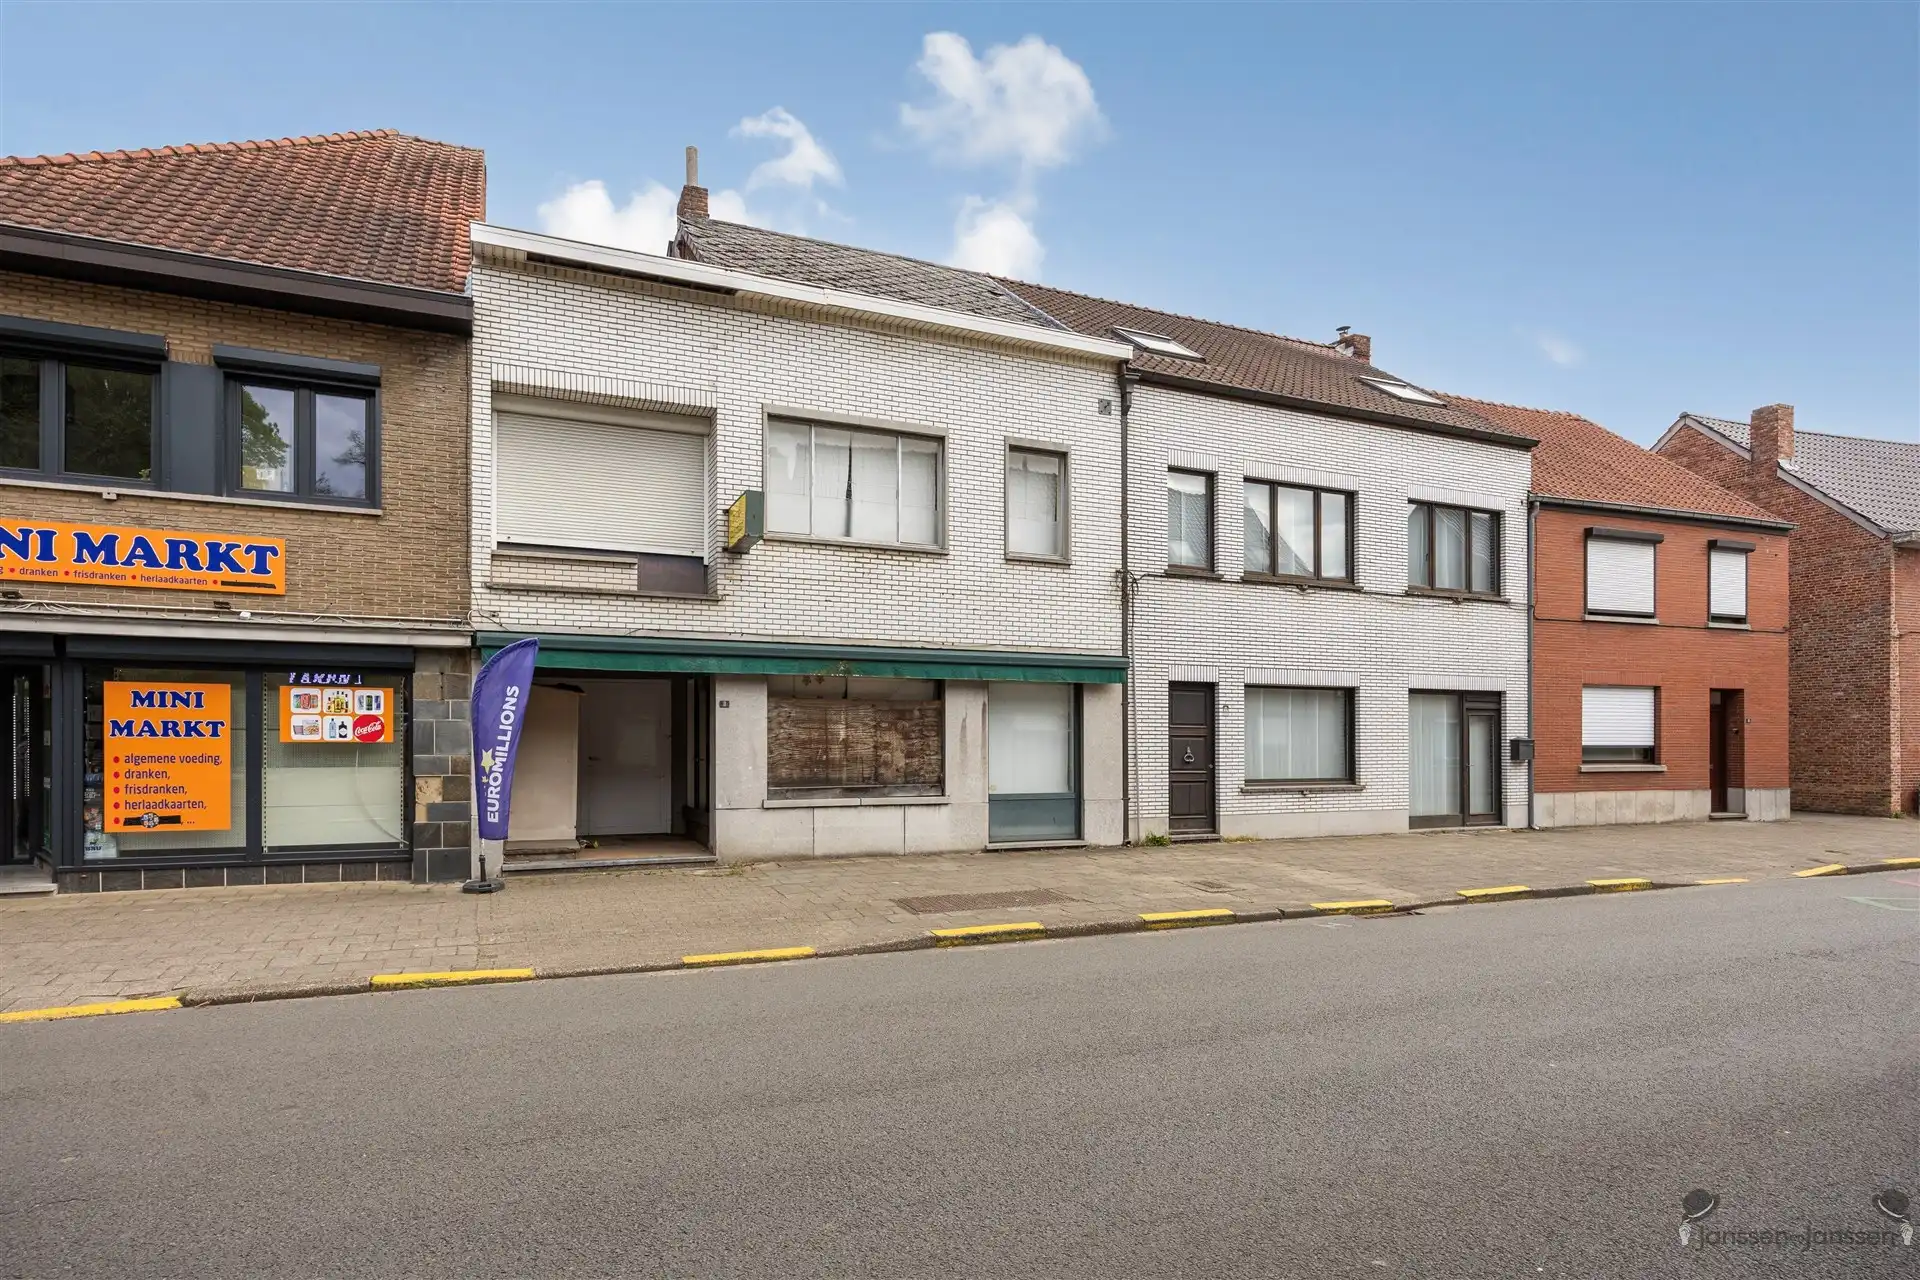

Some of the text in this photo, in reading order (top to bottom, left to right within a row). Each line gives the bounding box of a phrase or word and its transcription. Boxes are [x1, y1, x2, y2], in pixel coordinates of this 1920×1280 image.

[72, 531, 280, 576] MARKT
[19, 566, 208, 585] dranken frisdranken herlaadkaarten
[130, 689, 205, 709] MINI
[109, 719, 225, 738] MARKT
[124, 753, 222, 766] algemene voeding,
[487, 685, 520, 823] EUROMILLIONS
[124, 768, 171, 780] dranken,
[124, 784, 188, 795] frisdranken,
[124, 799, 207, 810] herlaadkaarten,
